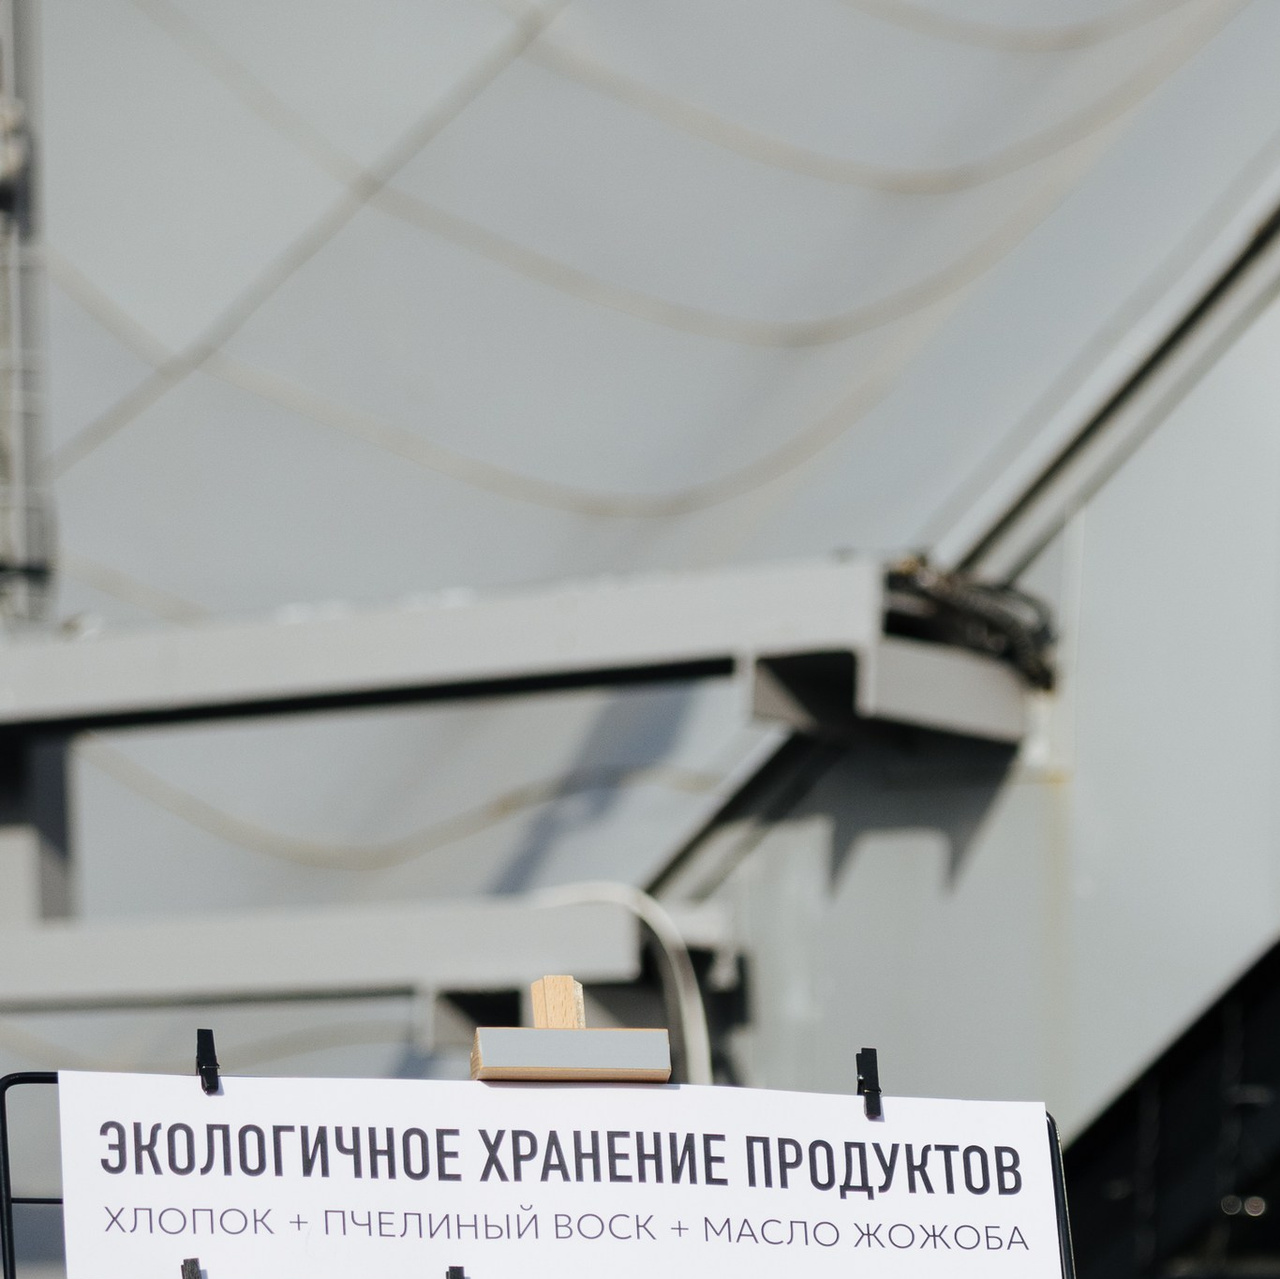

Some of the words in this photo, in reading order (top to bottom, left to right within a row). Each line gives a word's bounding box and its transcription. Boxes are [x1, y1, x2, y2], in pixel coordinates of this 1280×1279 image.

[99, 1120, 462, 1183] ЭКОЛОГИЧНОЕ
[478, 1128, 729, 1188] ХРАНЕНИЕ
[745, 1134, 1023, 1201] ПРОДУКТОВ
[103, 1206, 276, 1236] ХЛОПОК
[289, 1212, 309, 1233] +
[323, 1204, 540, 1241] ПЧЕЛИНЫЙ
[553, 1212, 657, 1241] ВОСК
[670, 1219, 690, 1239] +
[703, 1215, 841, 1249] МАСЛО
[853, 1221, 1031, 1252] ЖОЖОБА
